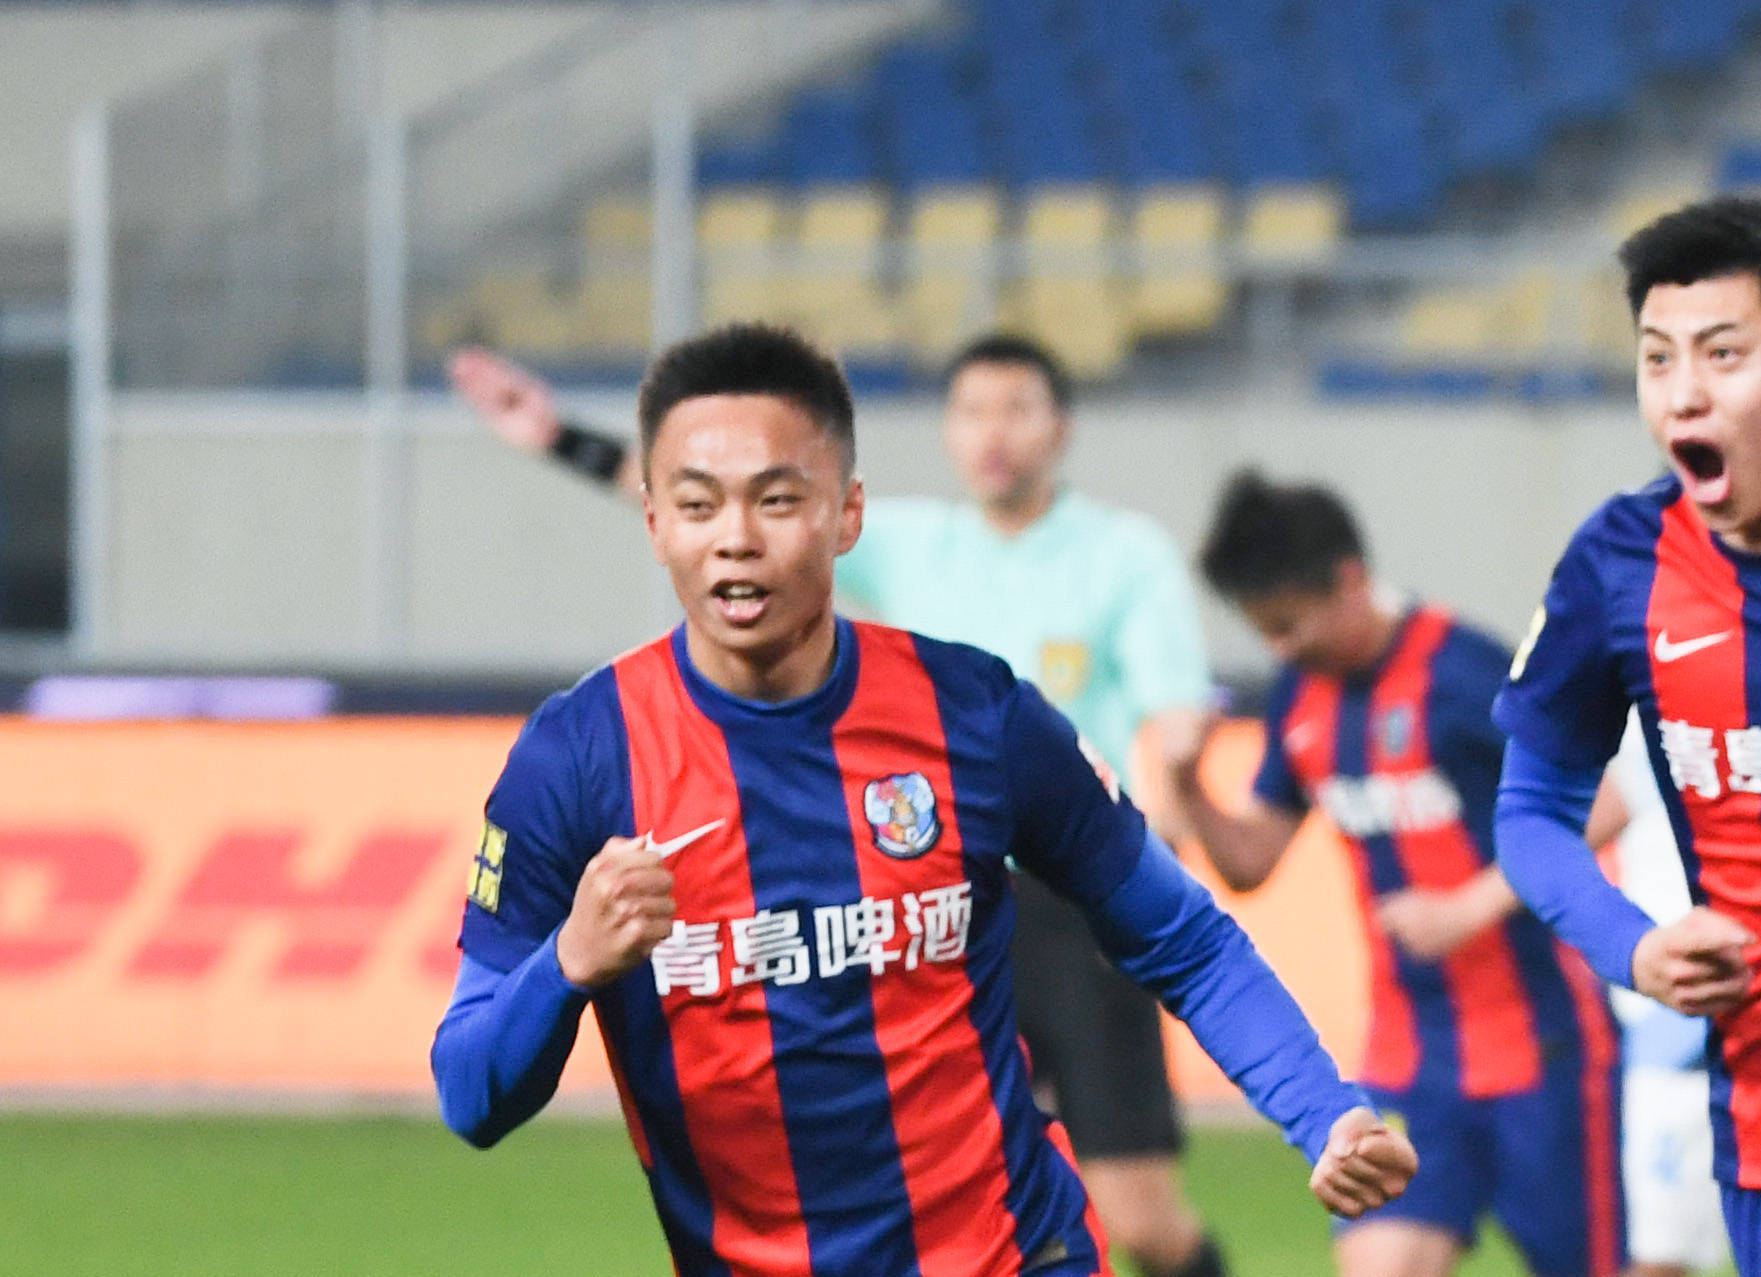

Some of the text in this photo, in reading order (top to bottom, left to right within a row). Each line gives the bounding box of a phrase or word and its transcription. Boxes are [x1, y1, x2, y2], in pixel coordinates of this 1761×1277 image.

[0, 824, 464, 983] DH
[651, 880, 973, 996] 青島啤酒
